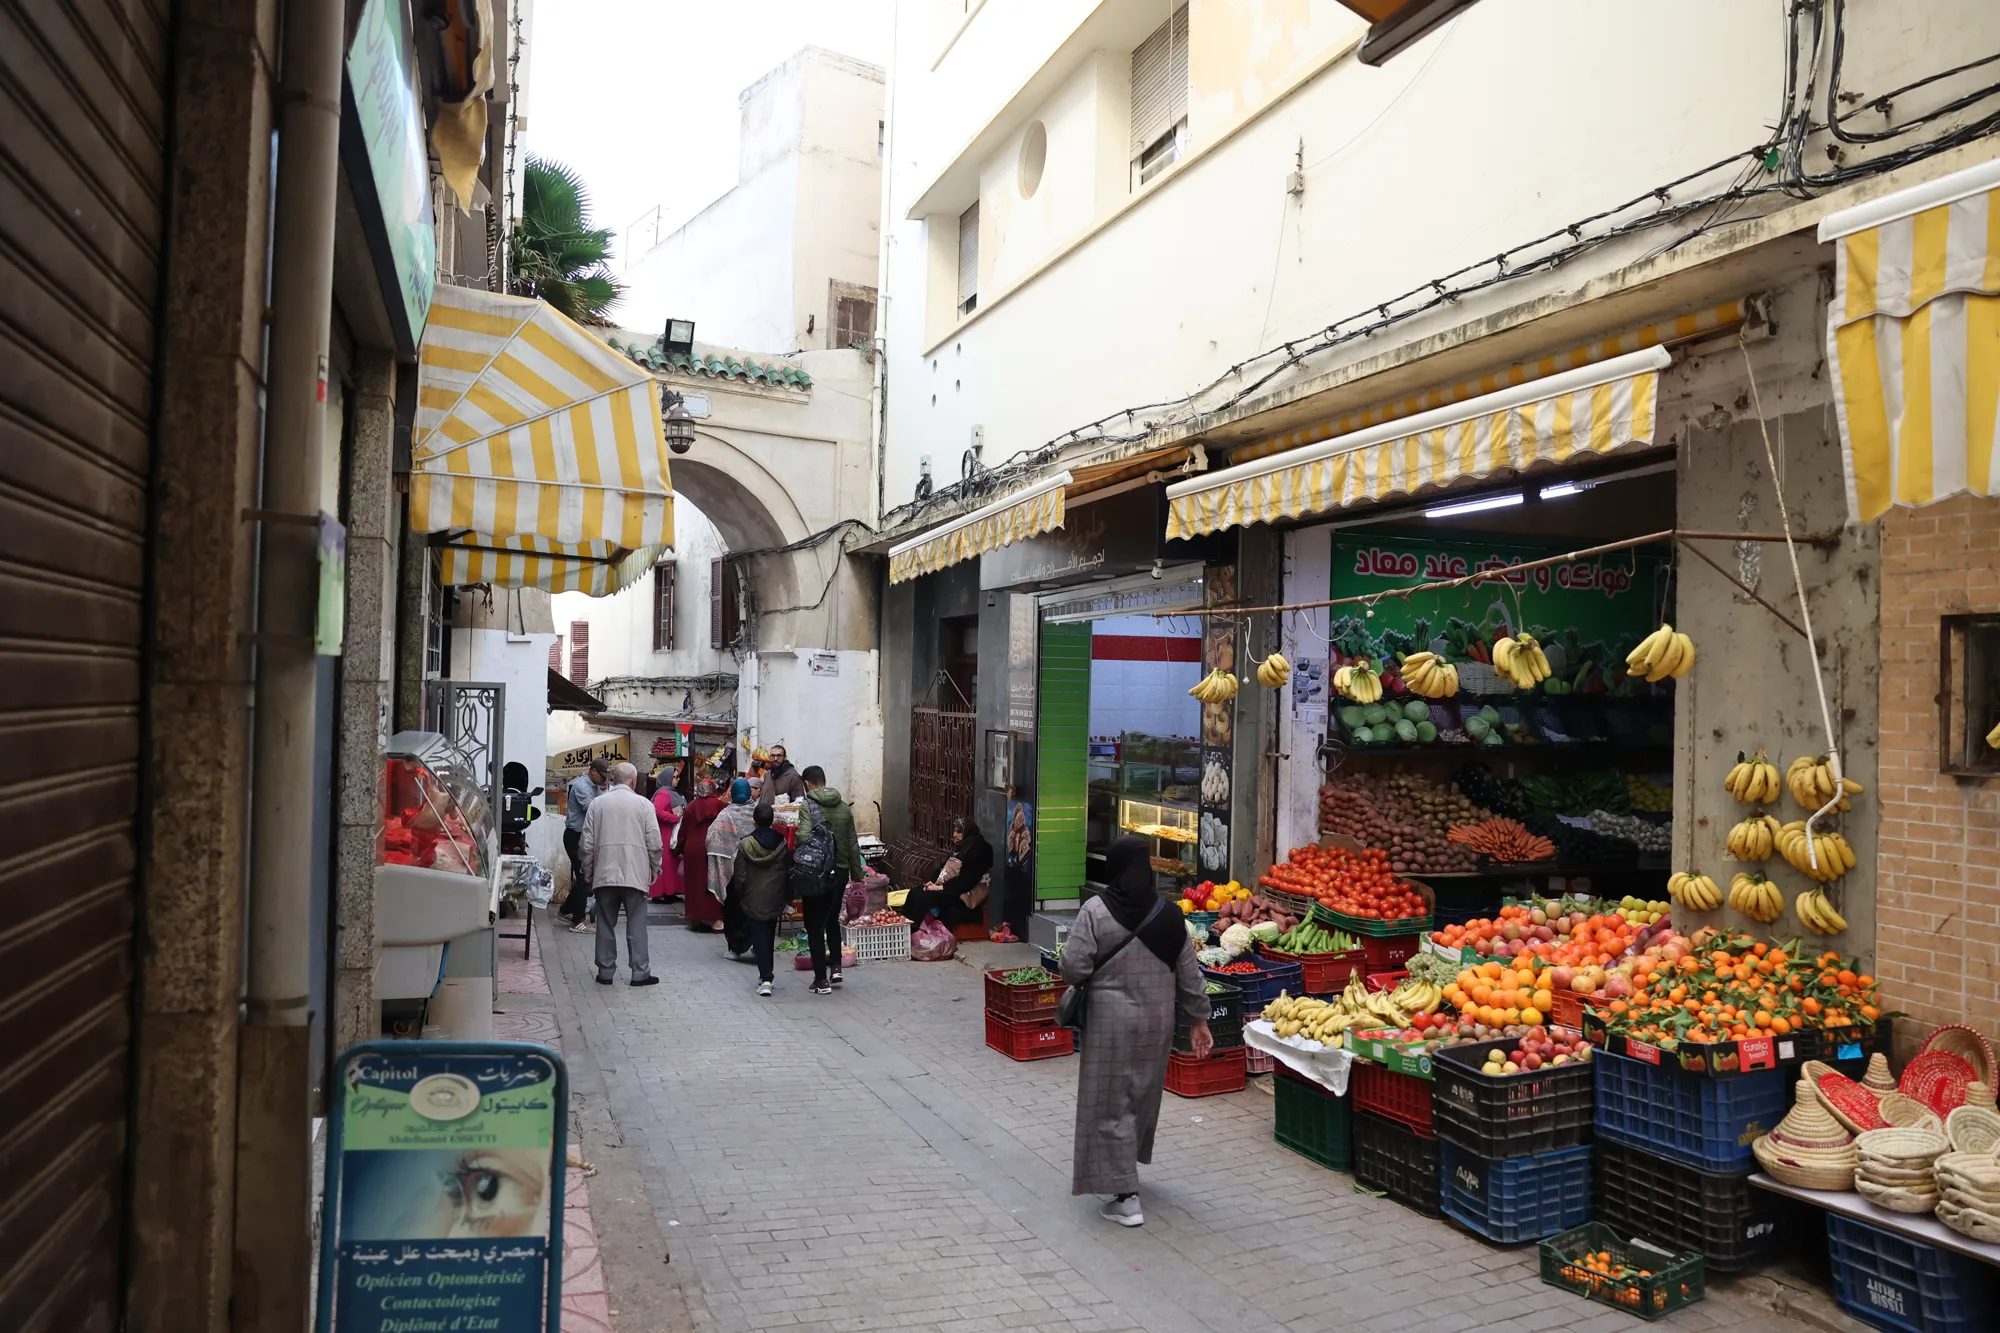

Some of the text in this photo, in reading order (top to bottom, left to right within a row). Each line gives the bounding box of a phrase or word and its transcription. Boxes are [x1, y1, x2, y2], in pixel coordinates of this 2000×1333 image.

[1354, 547, 1419, 576] معاد
[1424, 552, 1468, 579] عند
[1743, 1042, 1768, 1052] Eureka
[1749, 1050, 1768, 1060] fresh
[360, 1065, 418, 1083] Capitol
[356, 1269, 526, 1291] Opticien Optométriste
[1866, 1278, 1903, 1303] FRUIT
[380, 1294, 501, 1310] Contactologiste
[1869, 1290, 1907, 1316] TISSIR
